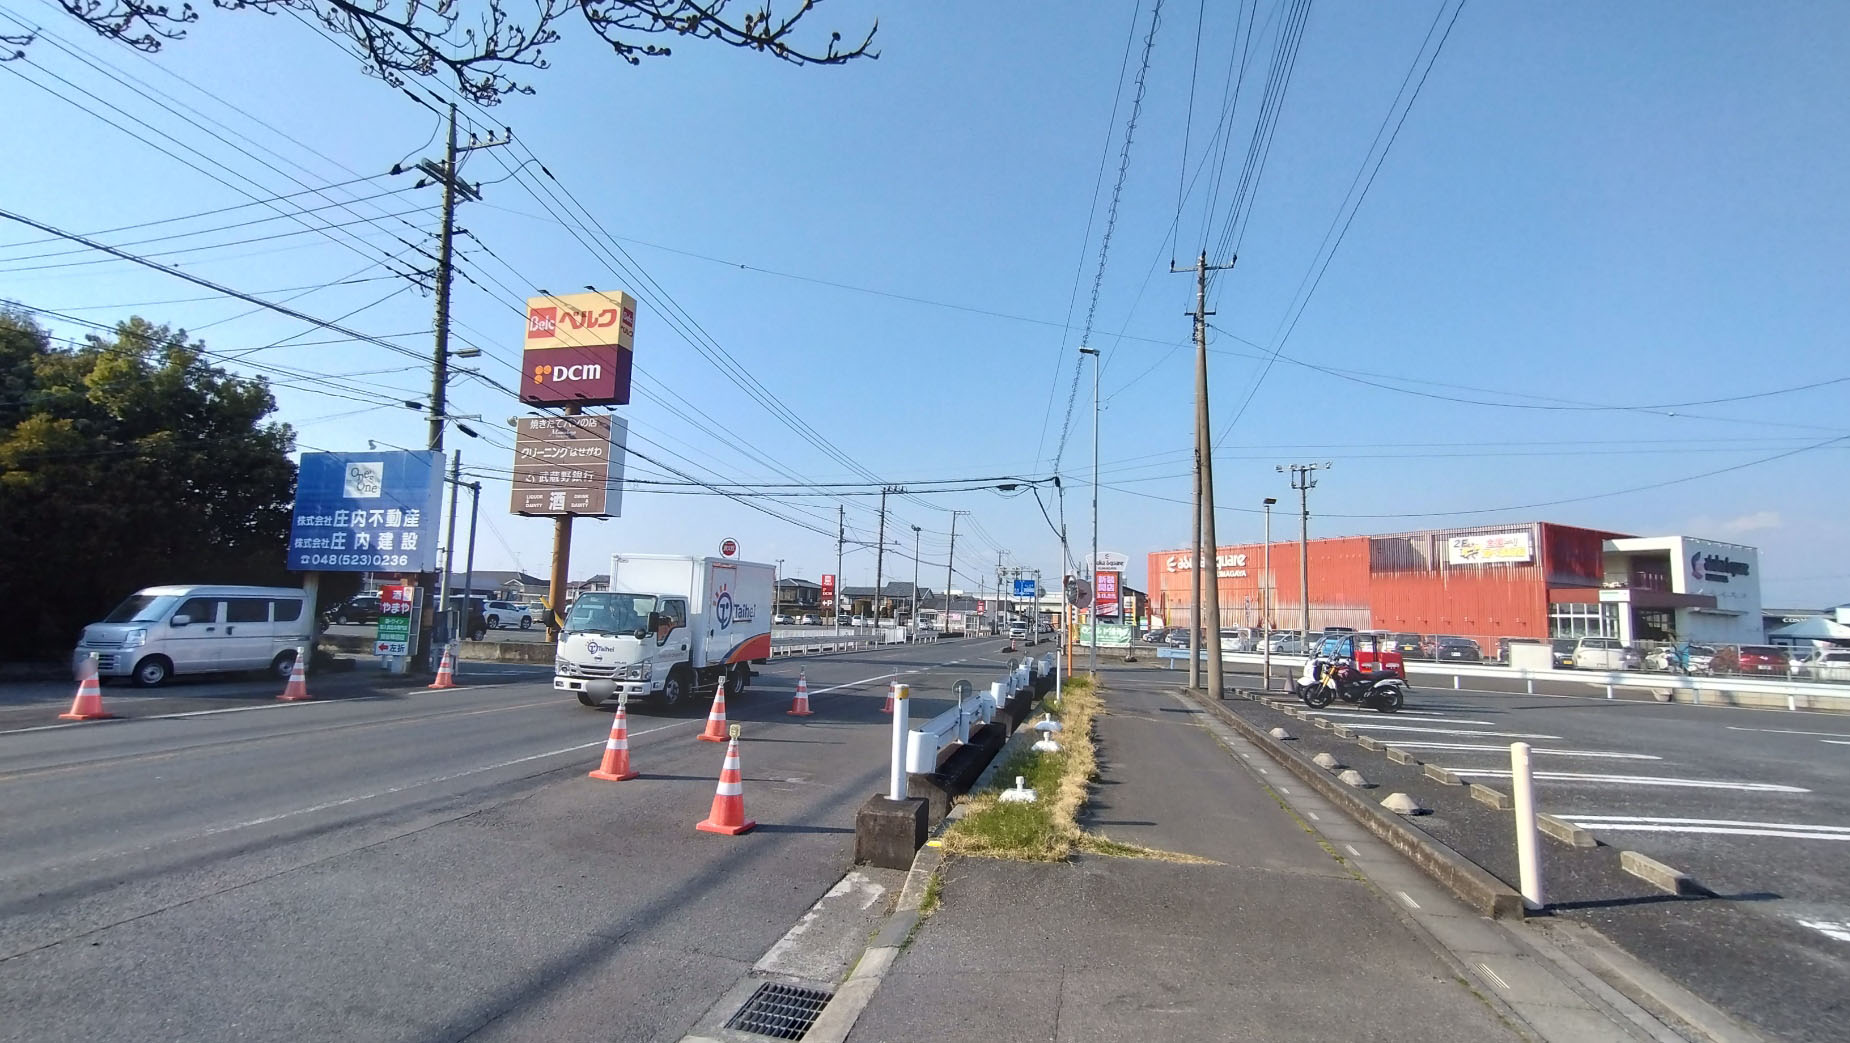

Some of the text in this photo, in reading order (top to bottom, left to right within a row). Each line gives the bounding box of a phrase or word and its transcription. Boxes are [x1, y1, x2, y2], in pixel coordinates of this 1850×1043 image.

[529, 315, 555, 331] Belc
[559, 309, 618, 329] ベルク
[552, 364, 601, 382] DCM
[538, 471, 595, 483] 武蔵野銀行
[357, 482, 378, 494] One
[548, 491, 567, 511] 酒
[312, 554, 408, 567] 048(523)0236
[382, 601, 410, 614] やまや
[734, 603, 756, 619] Taihei
[389, 644, 406, 653] 左折
[598, 645, 615, 653] Taihei
